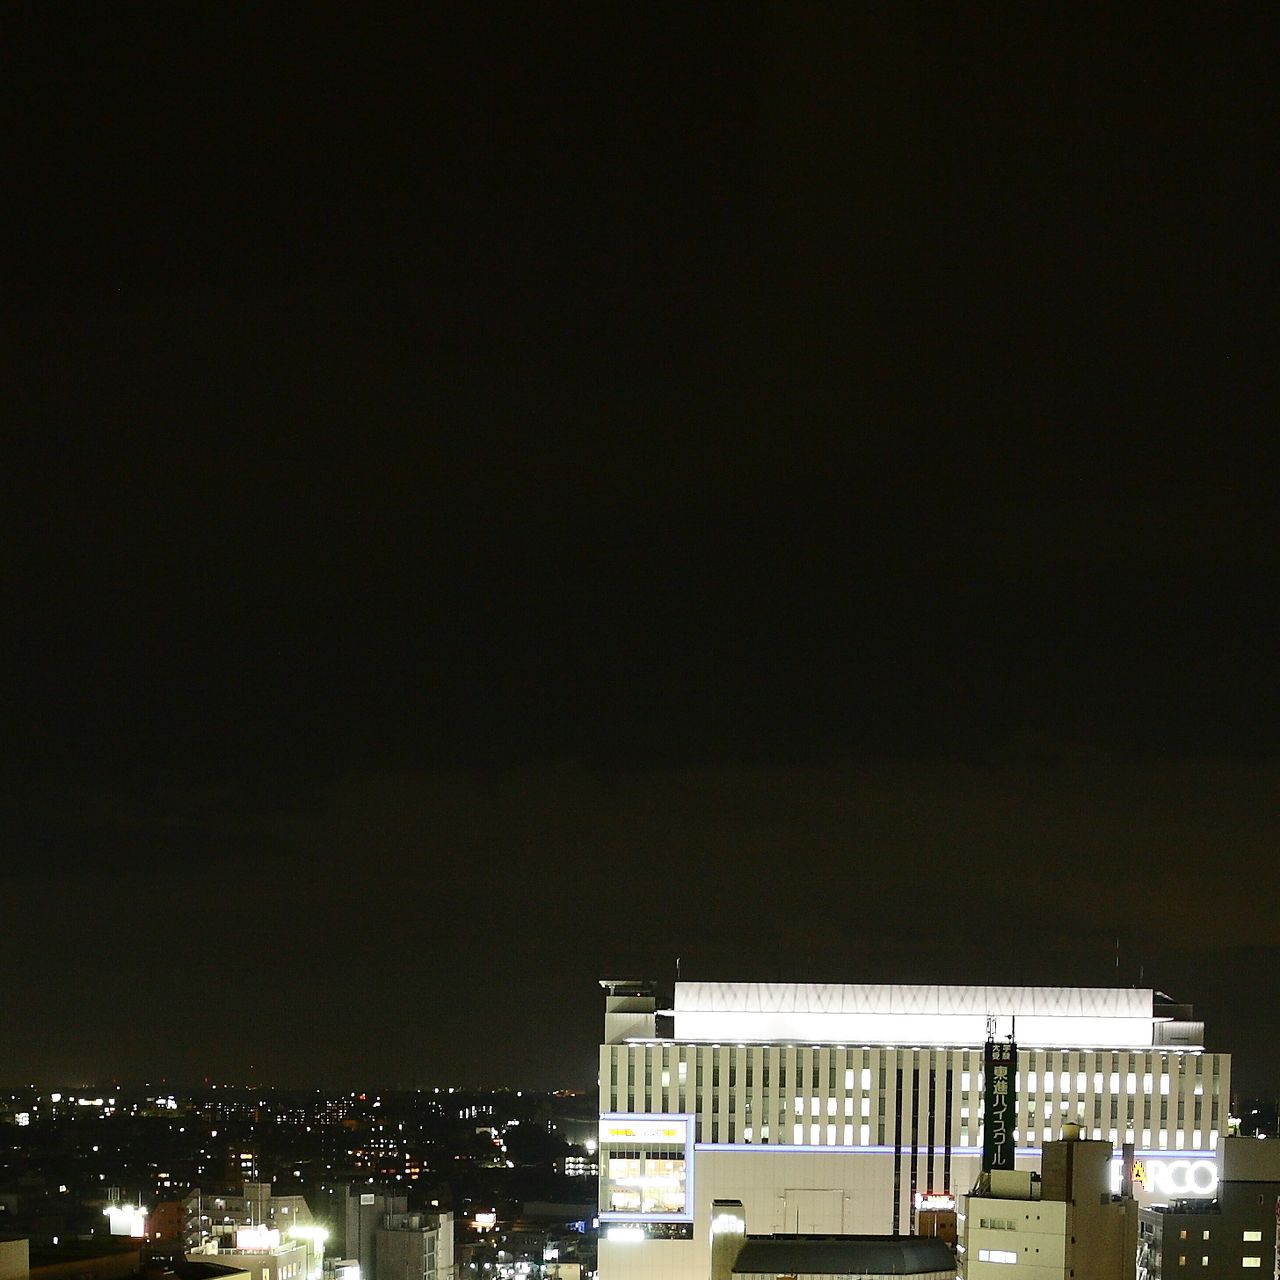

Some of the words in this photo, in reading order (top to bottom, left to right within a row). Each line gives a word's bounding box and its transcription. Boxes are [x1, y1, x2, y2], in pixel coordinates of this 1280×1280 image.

[992, 1066, 1008, 1165] 東進ハイスクール
